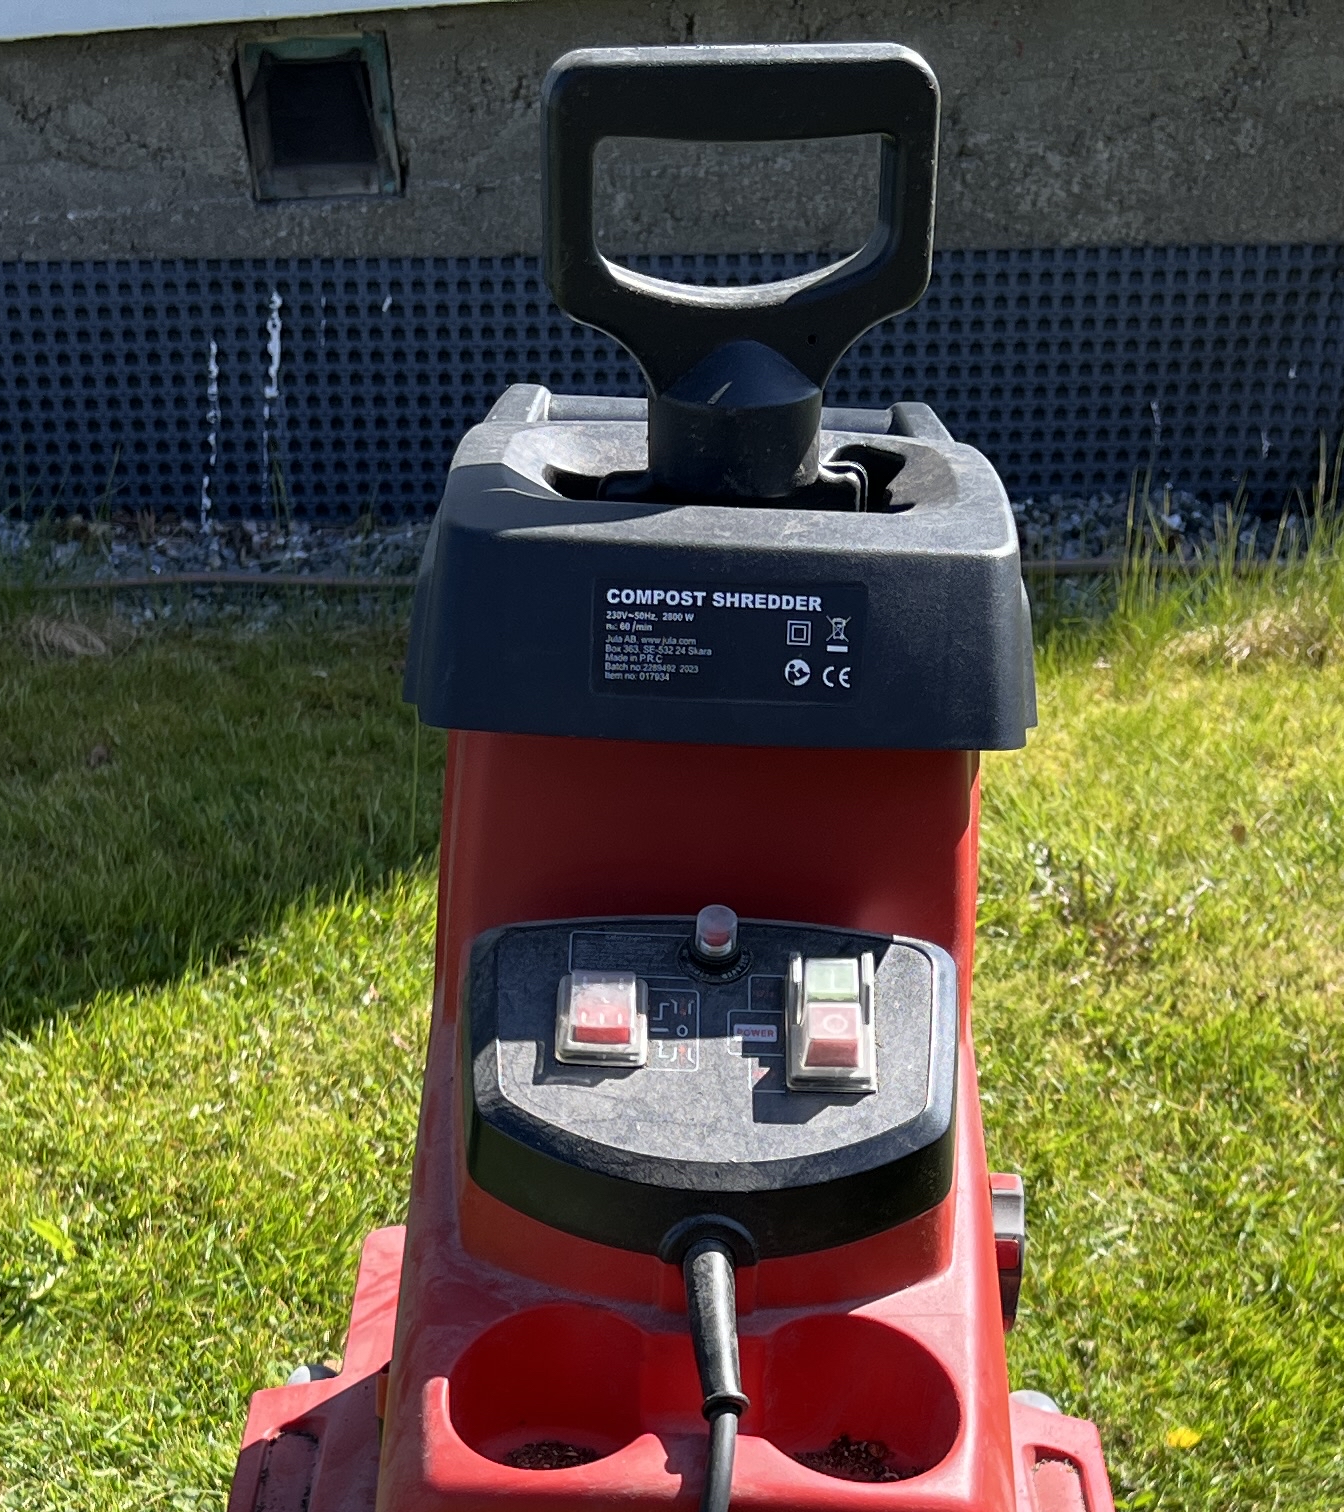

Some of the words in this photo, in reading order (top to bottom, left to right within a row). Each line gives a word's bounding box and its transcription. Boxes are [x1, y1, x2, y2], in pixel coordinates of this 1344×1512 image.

[606, 588, 707, 607] COMPOST
[712, 592, 822, 612] SHREDDER
[684, 613, 695, 622] W
[605, 634, 623, 644] Jula
[640, 635, 697, 646] www.jula.com
[605, 643, 622, 653] Box
[642, 645, 674, 655] SE-532
[675, 646, 687, 656] 24
[687, 646, 713, 657] Skara
[604, 653, 629, 663] Made
[629, 654, 638, 662] in
[604, 662, 629, 671] Batch
[679, 664, 700, 674] 2023
[604, 671, 623, 680] Item
[822, 666, 851, 689] CE
[736, 1027, 775, 1038] POWER
